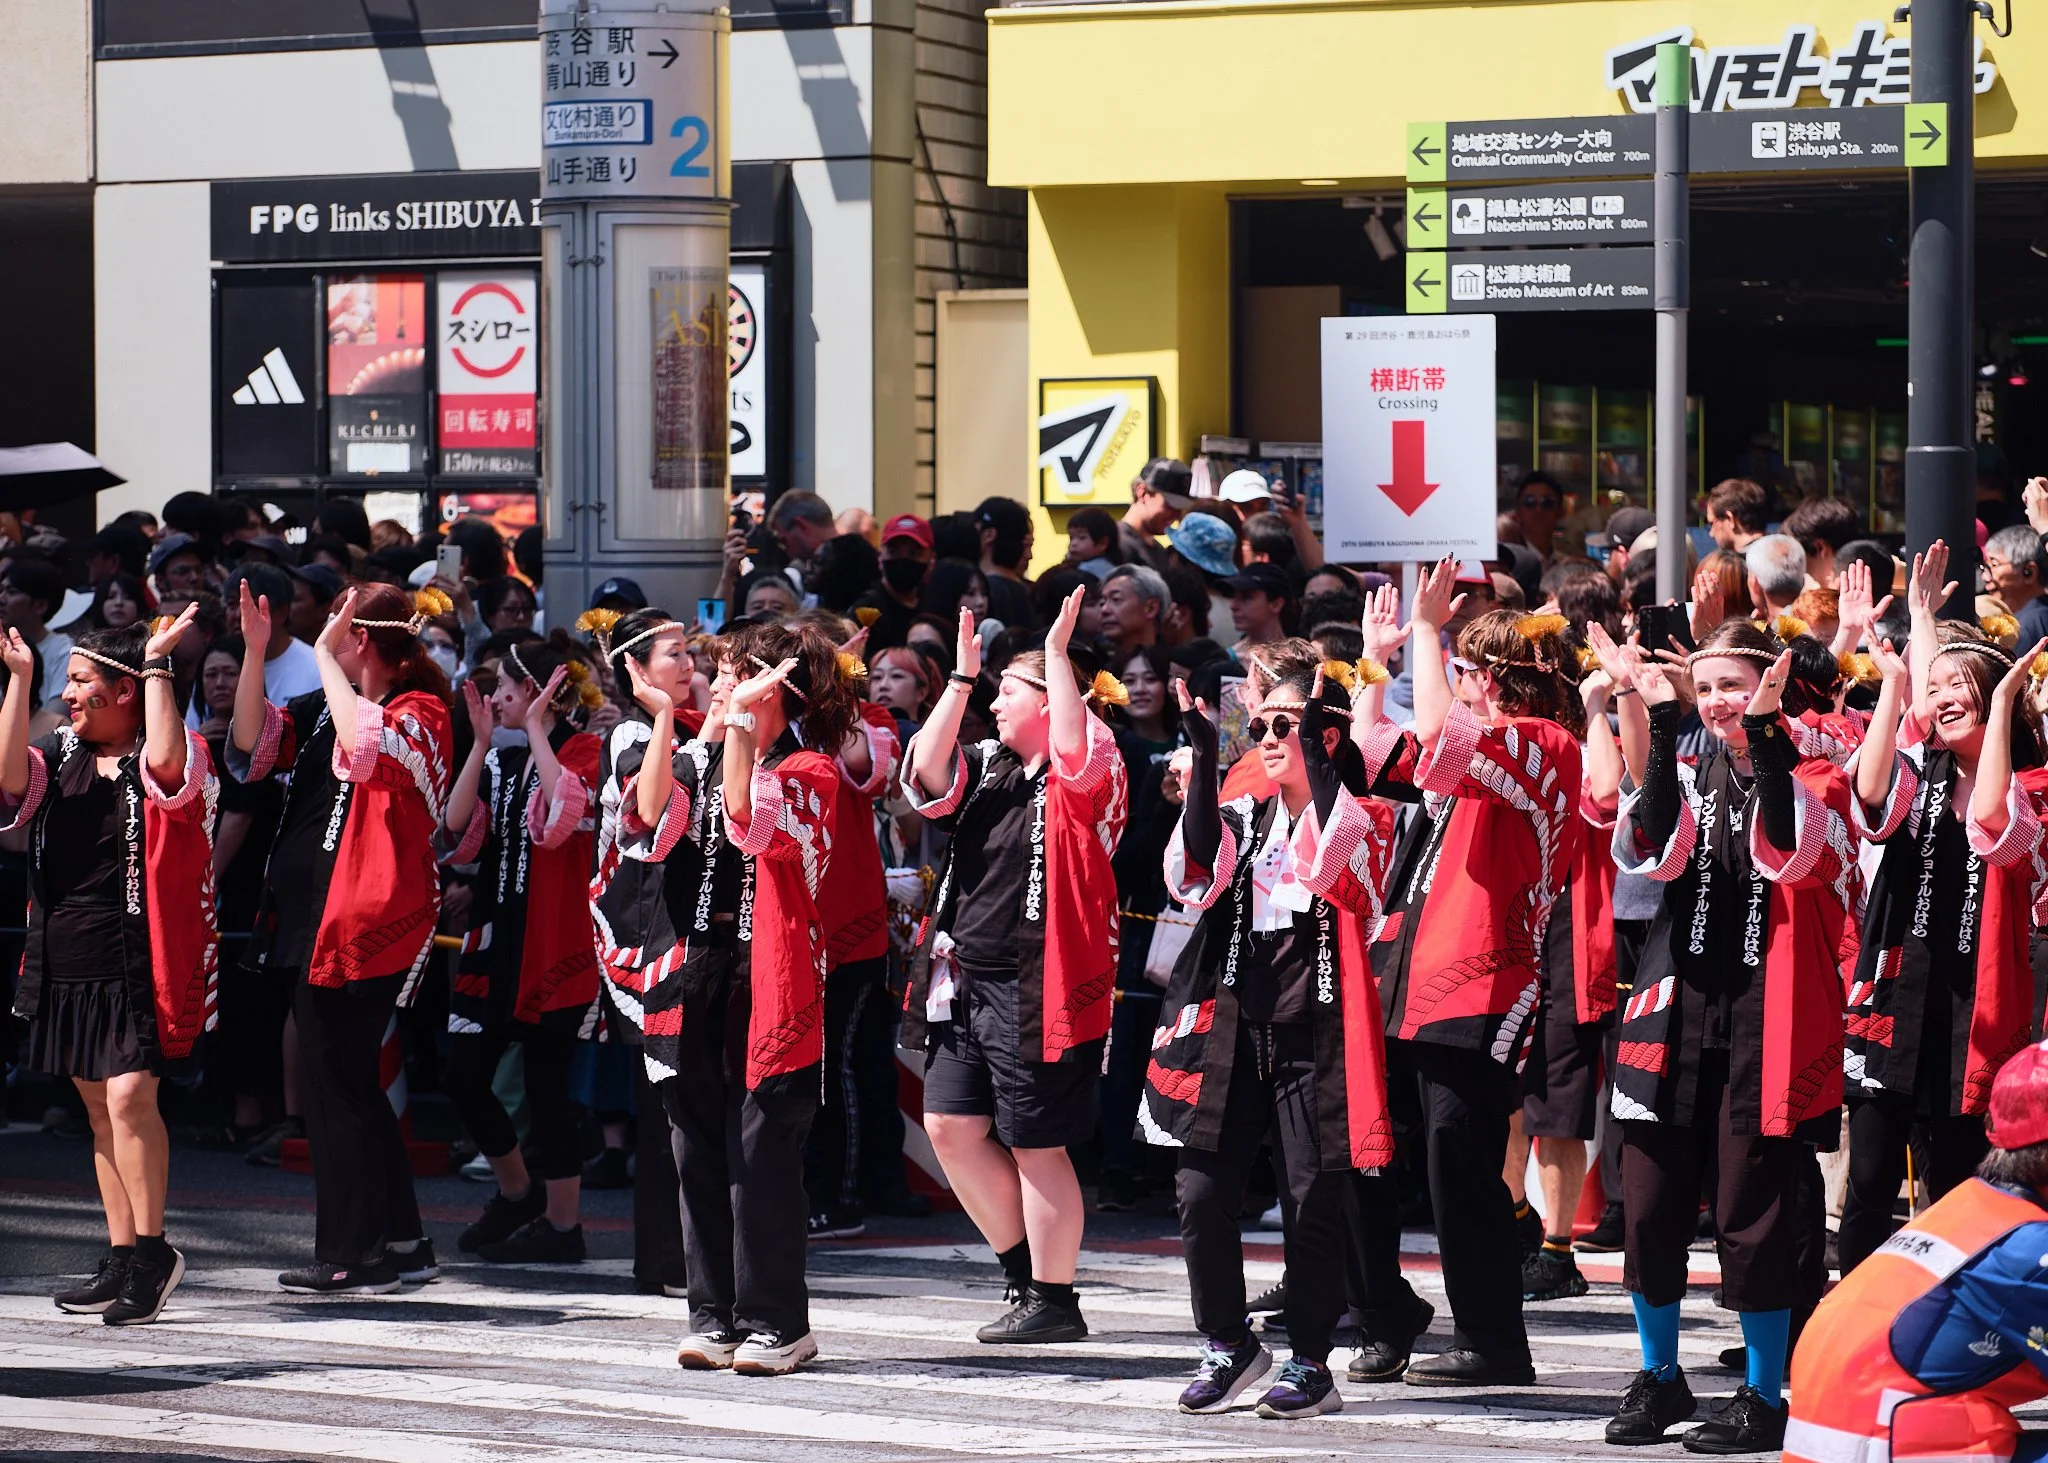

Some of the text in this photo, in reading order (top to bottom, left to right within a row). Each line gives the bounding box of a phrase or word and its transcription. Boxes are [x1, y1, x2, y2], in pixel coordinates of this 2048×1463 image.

[547, 61, 636, 90] 青山通り
[547, 105, 636, 130] 文化村通り
[554, 129, 623, 141] Bunkamura-Dori
[1451, 129, 1613, 153] 地域交流センター大向
[1787, 121, 1841, 141] 渋谷駅
[669, 116, 710, 178] 2
[1451, 150, 1650, 168] Omukai Community Center 700m
[1787, 141, 1899, 159] Shibuya Sta. 200m
[547, 156, 637, 185] 山手通り
[250, 203, 319, 235] FPG
[329, 202, 391, 232] links
[396, 198, 525, 231] SHIBUYA
[1486, 216, 1648, 233] Nabeshima Shoto Park 800m
[1486, 282, 1649, 299] Shoto Museum of Art 850m
[446, 320, 531, 343] スシロー
[1370, 367, 1446, 392] 横断帯
[1377, 395, 1438, 412] Crossing
[444, 408, 532, 433] 回転寿司
[1025, 773, 1047, 921] インターナショナルおはら
[1911, 779, 1948, 938] インターナショナルおはら
[1688, 788, 1718, 955] インターナショナルおはら
